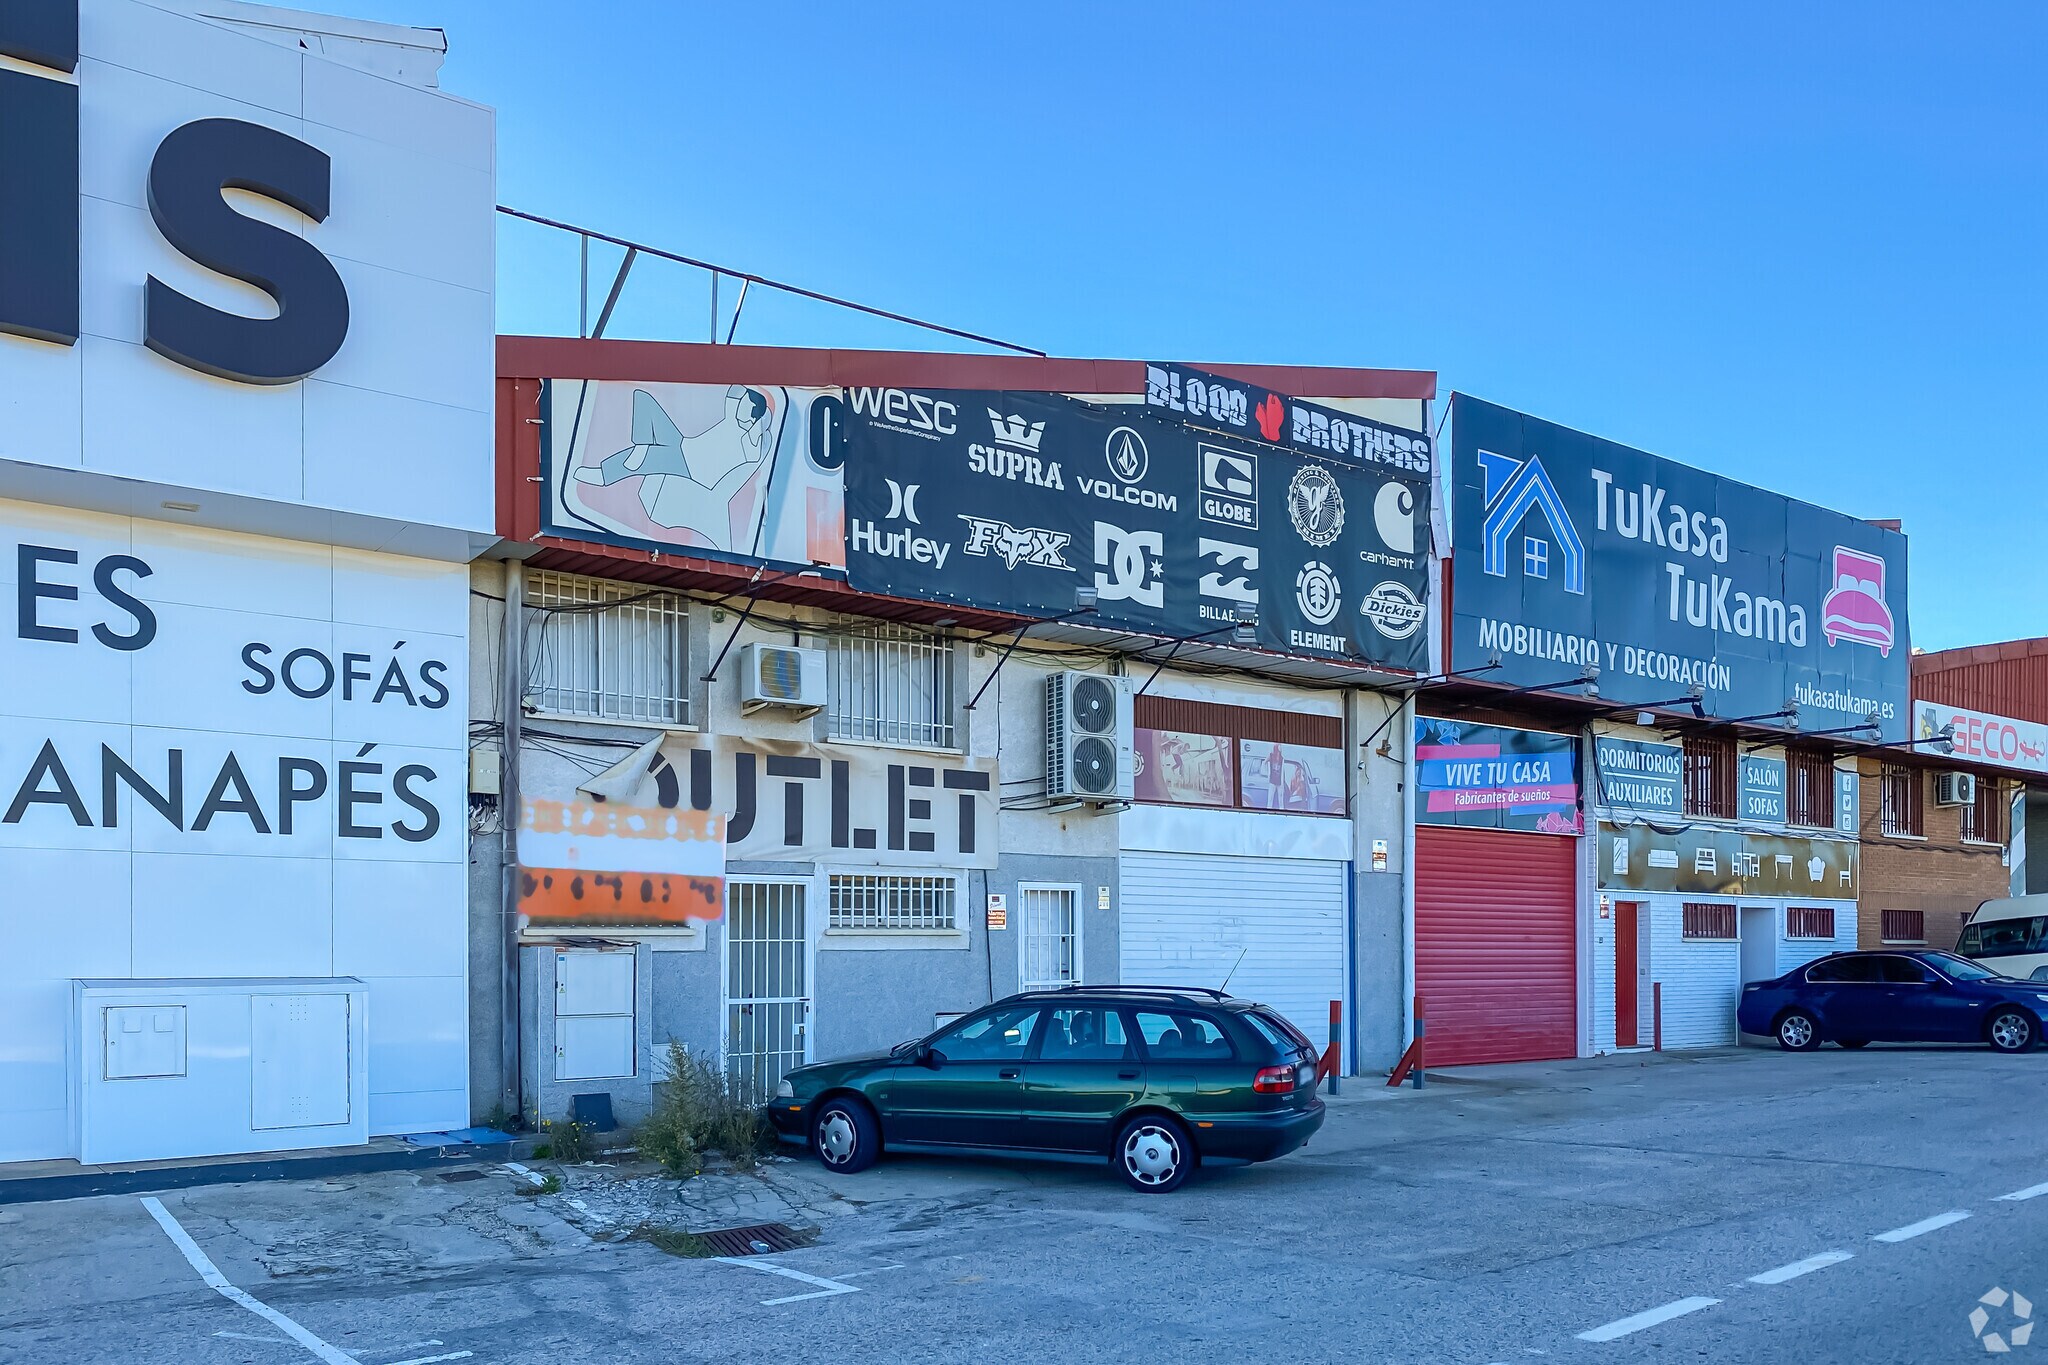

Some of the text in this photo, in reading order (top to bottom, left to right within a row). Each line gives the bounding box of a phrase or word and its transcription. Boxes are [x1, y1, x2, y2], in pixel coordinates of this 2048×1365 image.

[1147, 365, 1430, 473] BLOOD BROTHERS
[968, 443, 1065, 491] SUPRA
[1076, 476, 1177, 512] VOLCOM
[1205, 499, 1252, 523] GLOBE
[1591, 468, 1729, 563] TuKasa
[852, 518, 951, 570] Hurley
[1360, 550, 1415, 570] carhartt
[18, 543, 157, 651] ES
[1367, 600, 1422, 619] Dickies
[1666, 562, 1807, 648] TuKama
[1290, 629, 1346, 652] ELEMENT
[1479, 617, 1731, 692] MOBILIARIO Y DECORACIÓN
[241, 640, 450, 709] SOFÁS
[1794, 682, 1894, 720] tukasatukama.es
[1951, 715, 2019, 761] GECO
[1446, 761, 1551, 786] VIVE TU CASA
[1600, 747, 1680, 775] DORMITORIOS
[1747, 765, 1779, 787] SALÓN
[1, 736, 441, 842] ANAPÉS
[1454, 789, 1551, 806] Fabricantes de sueños
[1607, 781, 1673, 806] AUXILIARES
[1747, 797, 1779, 817] SOFAS
